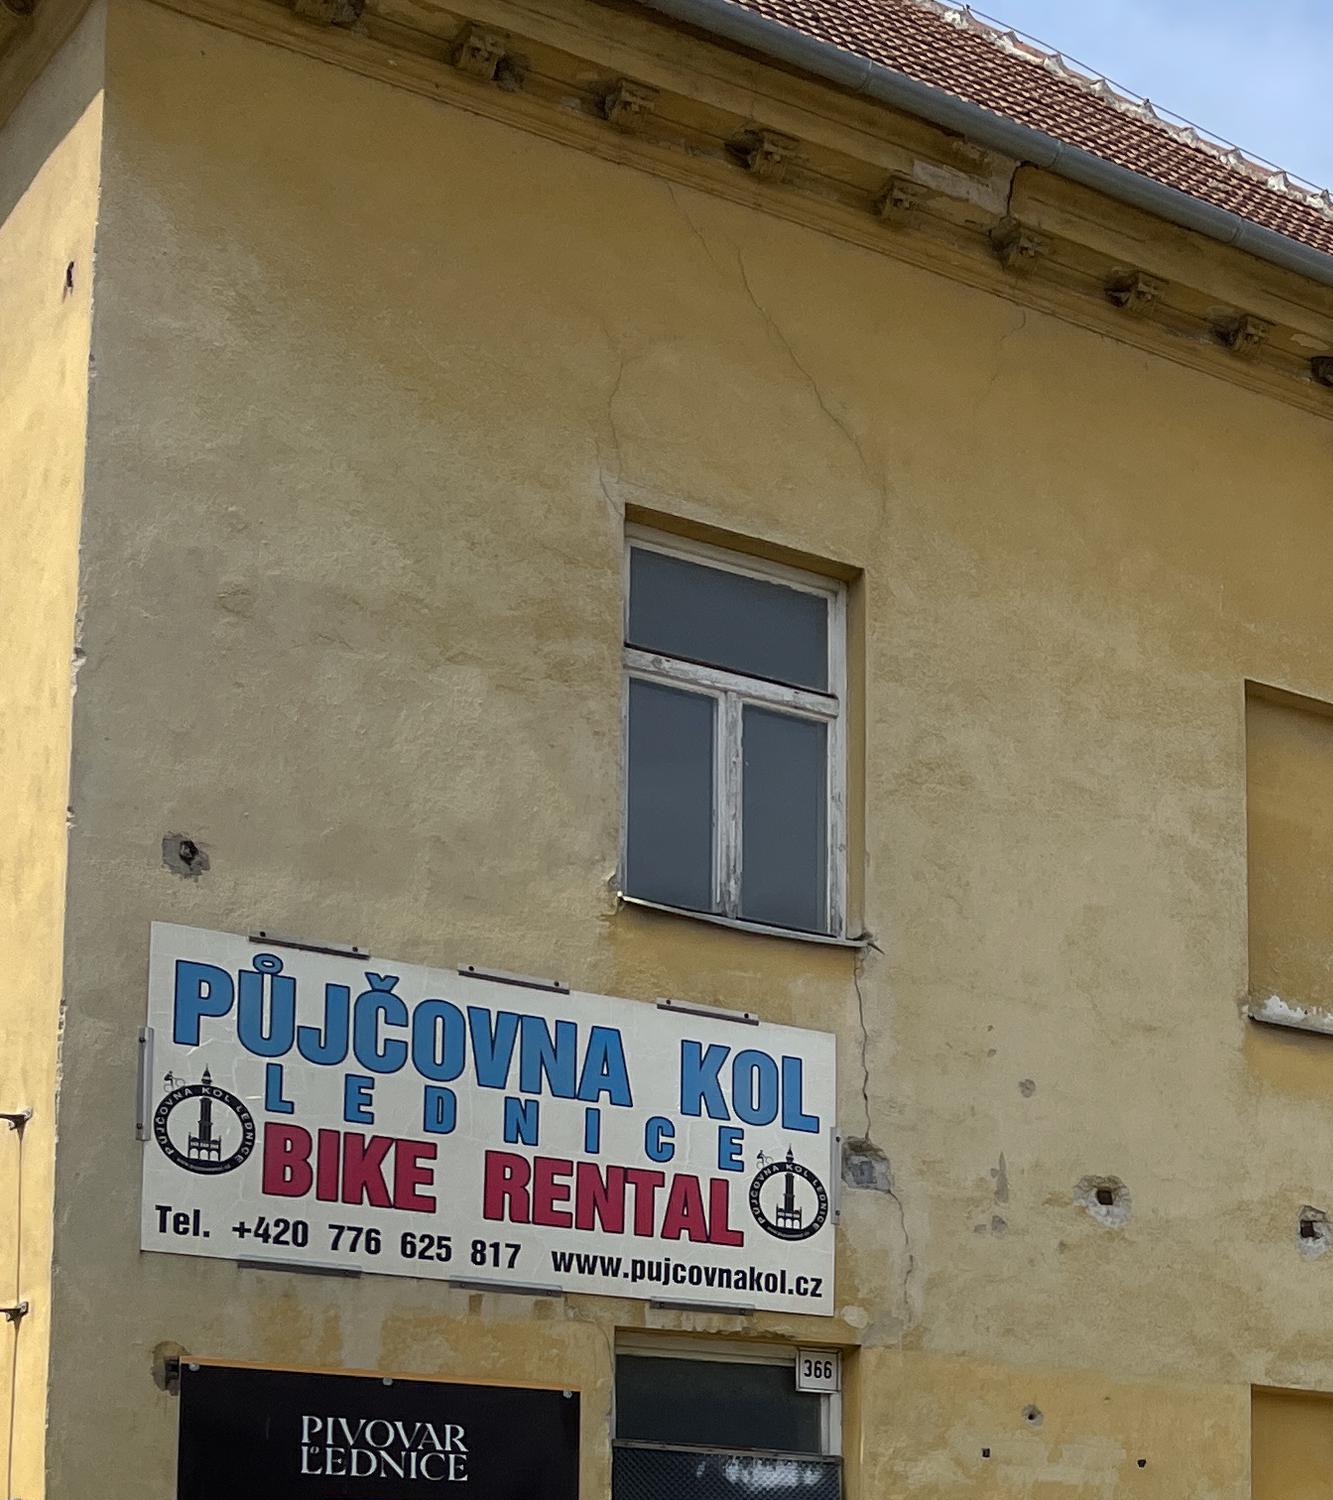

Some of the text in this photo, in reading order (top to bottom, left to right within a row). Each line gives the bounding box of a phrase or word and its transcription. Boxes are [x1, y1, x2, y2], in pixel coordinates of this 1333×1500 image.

[172, 953, 820, 1133] PŮJČOVNA KOL
[202, 1087, 230, 1102] KOL
[235, 1105, 254, 1163] LEDNICE
[261, 1122, 744, 1247] BIKE RENTAL
[785, 1164, 809, 1177] KOL
[155, 1205, 823, 1298] Tel. +420 776 625 817 www.pujcovnakol.cz
[803, 1360, 833, 1378] 366
[301, 1415, 469, 1452] PIVOVAR
